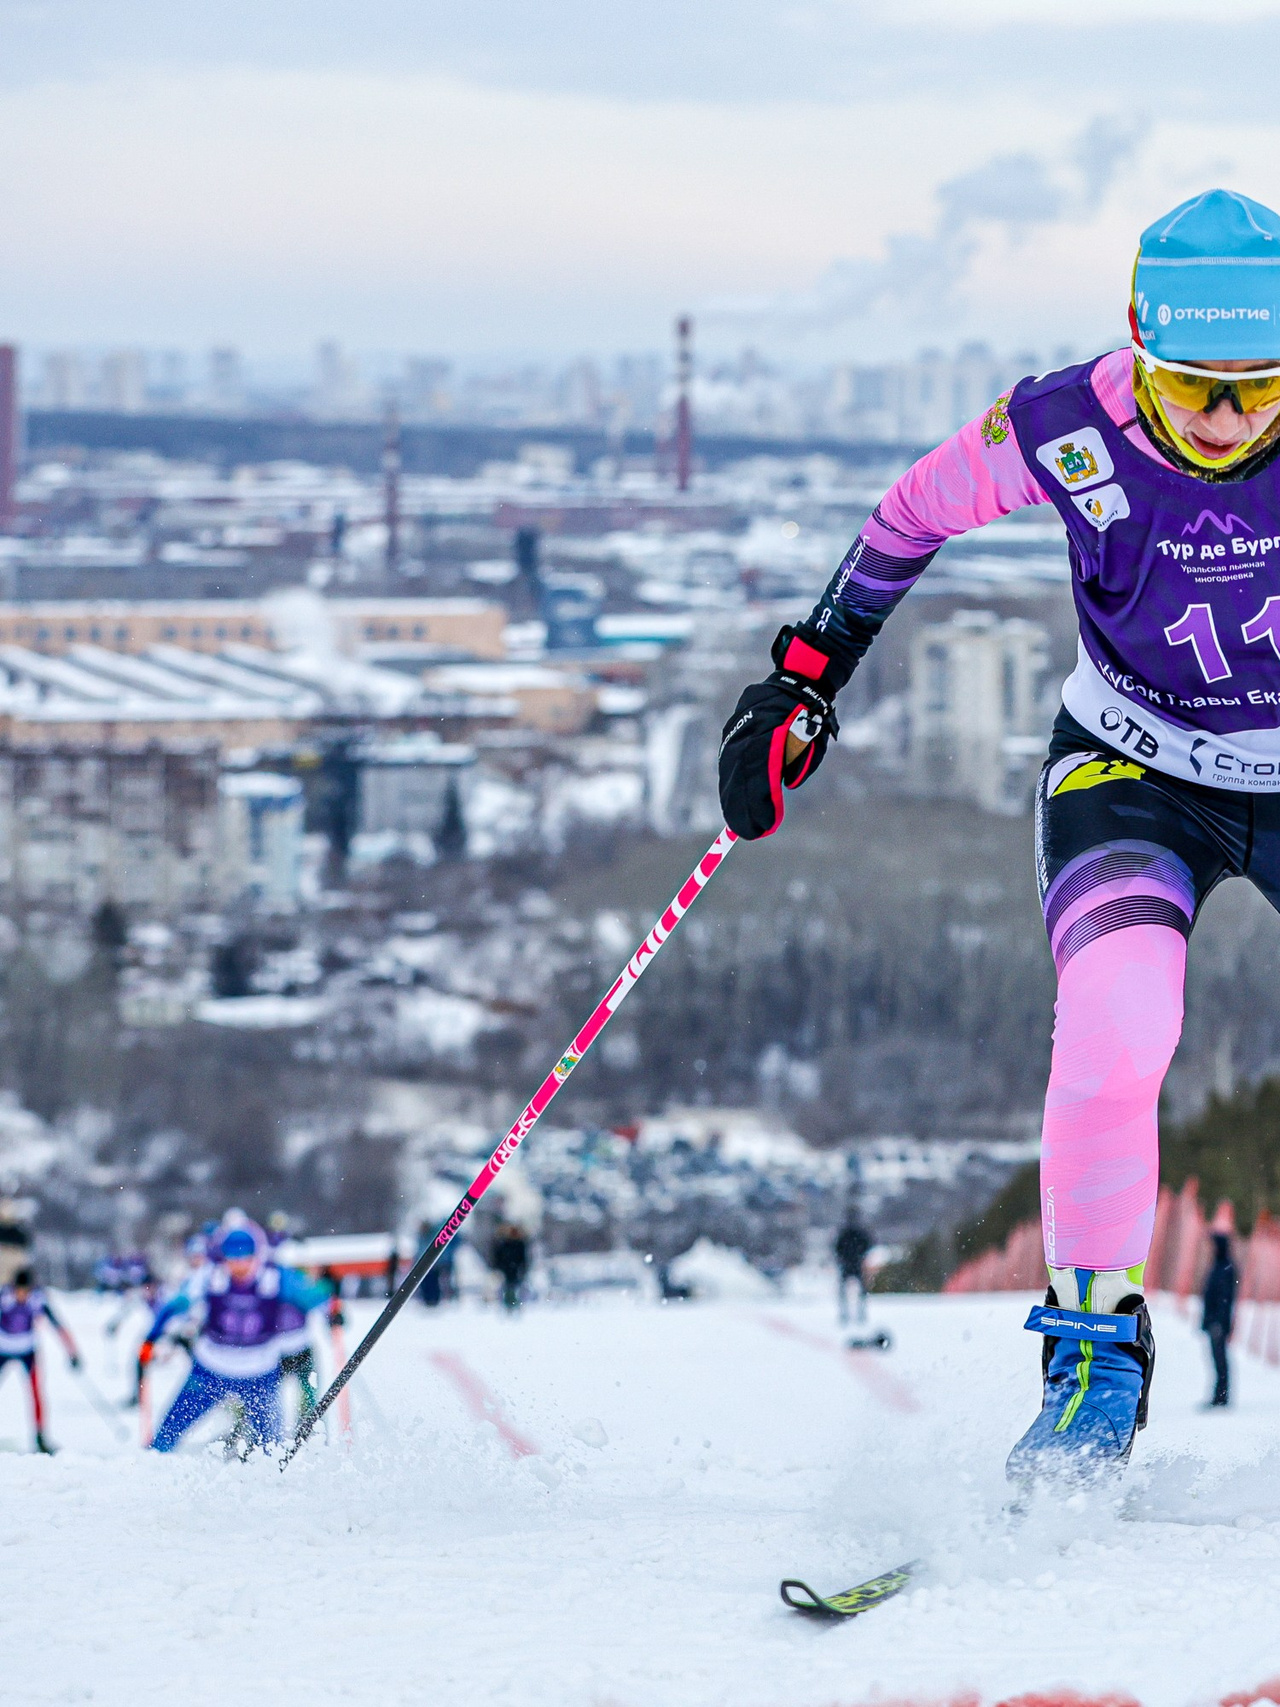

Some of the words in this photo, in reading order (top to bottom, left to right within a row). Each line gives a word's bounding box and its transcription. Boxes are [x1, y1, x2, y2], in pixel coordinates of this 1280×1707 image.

[1174, 307, 1270, 323] открытие
[1156, 540, 1195, 560] Тур
[1200, 544, 1227, 560] де
[831, 535, 871, 605] VICTORY
[1180, 563, 1227, 575] Уральская
[1229, 560, 1266, 572] лыжная
[1195, 571, 1255, 584] многодневка
[1098, 660, 1162, 705] Кубок
[1212, 773, 1245, 786] группа
[1040, 1316, 1118, 1333] SPINE
